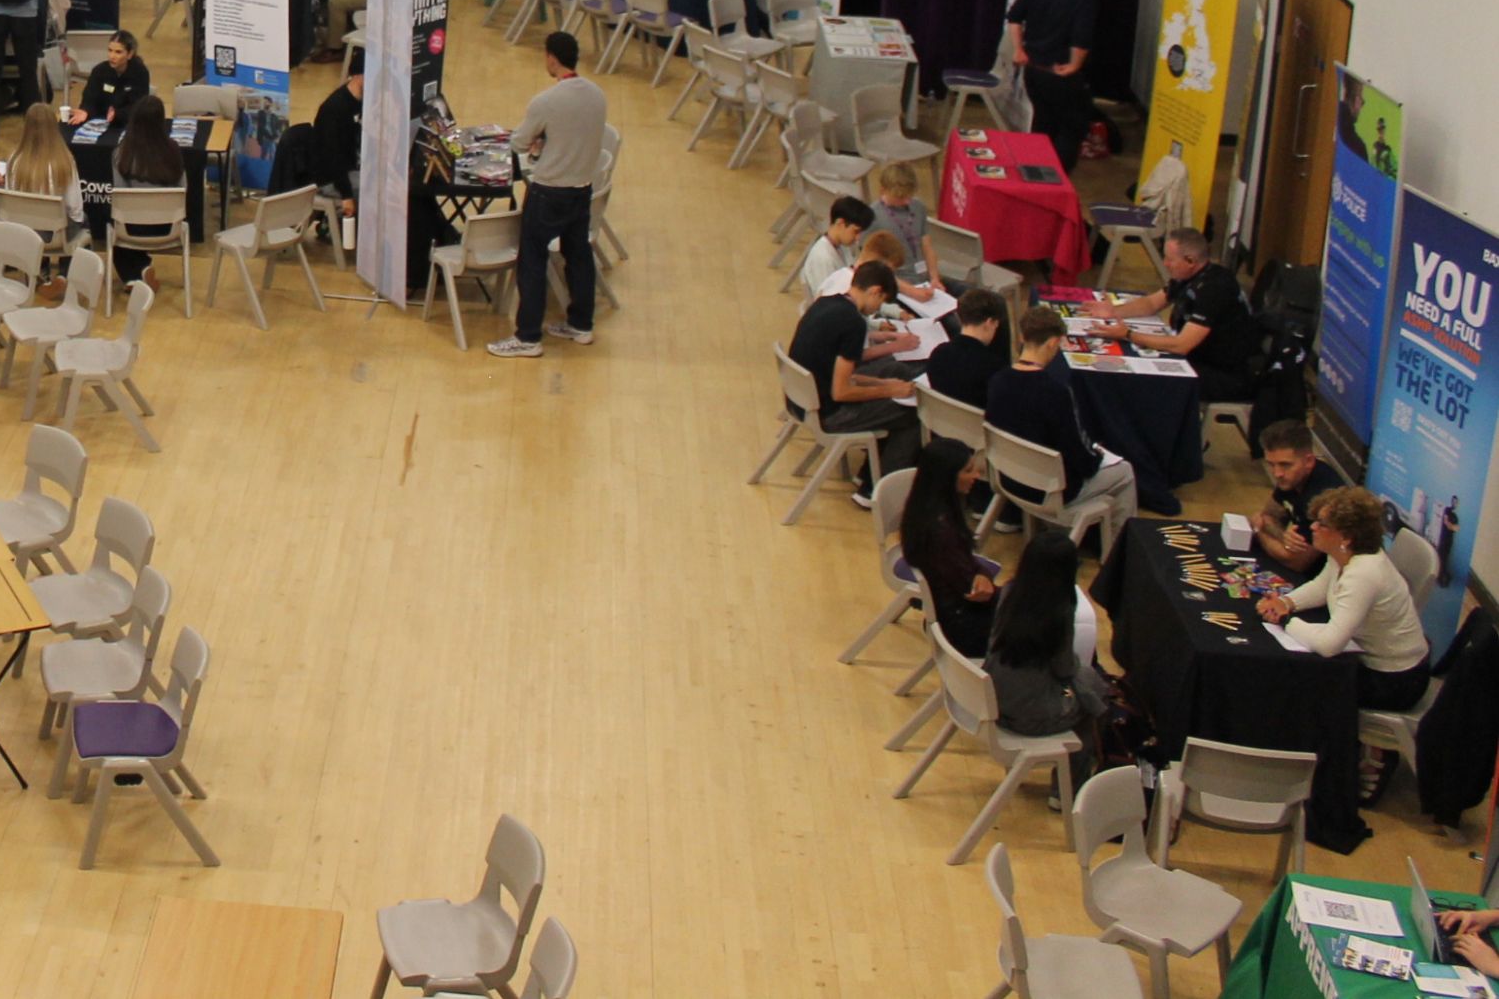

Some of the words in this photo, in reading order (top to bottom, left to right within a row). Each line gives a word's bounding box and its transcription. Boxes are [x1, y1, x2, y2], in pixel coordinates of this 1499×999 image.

[80, 179, 114, 194] Cove
[1341, 192, 1367, 223] POLICE
[1412, 241, 1492, 329] YOU
[1405, 291, 1439, 323] NEED
[1439, 312, 1451, 332] A
[1452, 319, 1483, 351] FULL
[1395, 363, 1433, 406] THE
[1434, 388, 1471, 430] LOT
[1444, 371, 1474, 403] GOT
